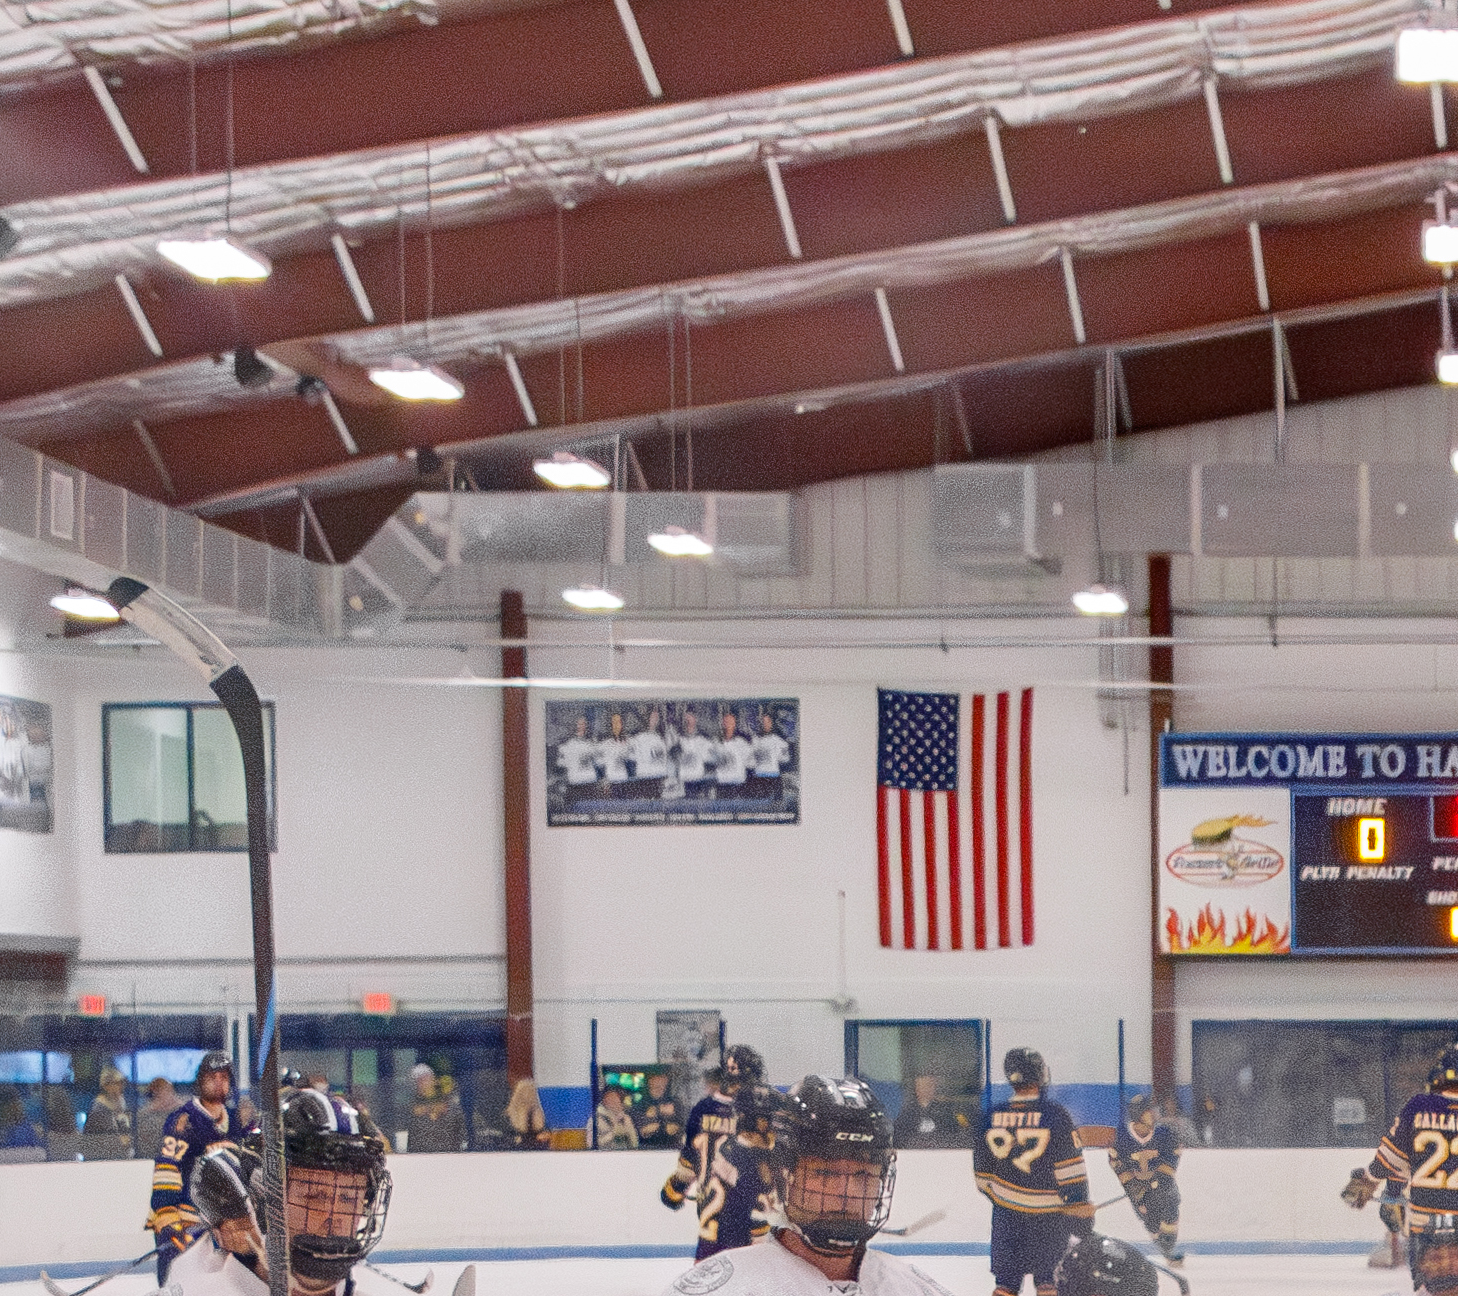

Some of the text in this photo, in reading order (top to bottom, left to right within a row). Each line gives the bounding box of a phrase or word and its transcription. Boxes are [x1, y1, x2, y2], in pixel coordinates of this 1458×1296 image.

[1171, 744, 1347, 779] WELCOME
[1355, 744, 1406, 779] TO
[1327, 797, 1388, 815] HOME
[1358, 817, 1385, 860] 0
[1346, 866, 1415, 880] PENALTY
[835, 1131, 874, 1143] CCM
